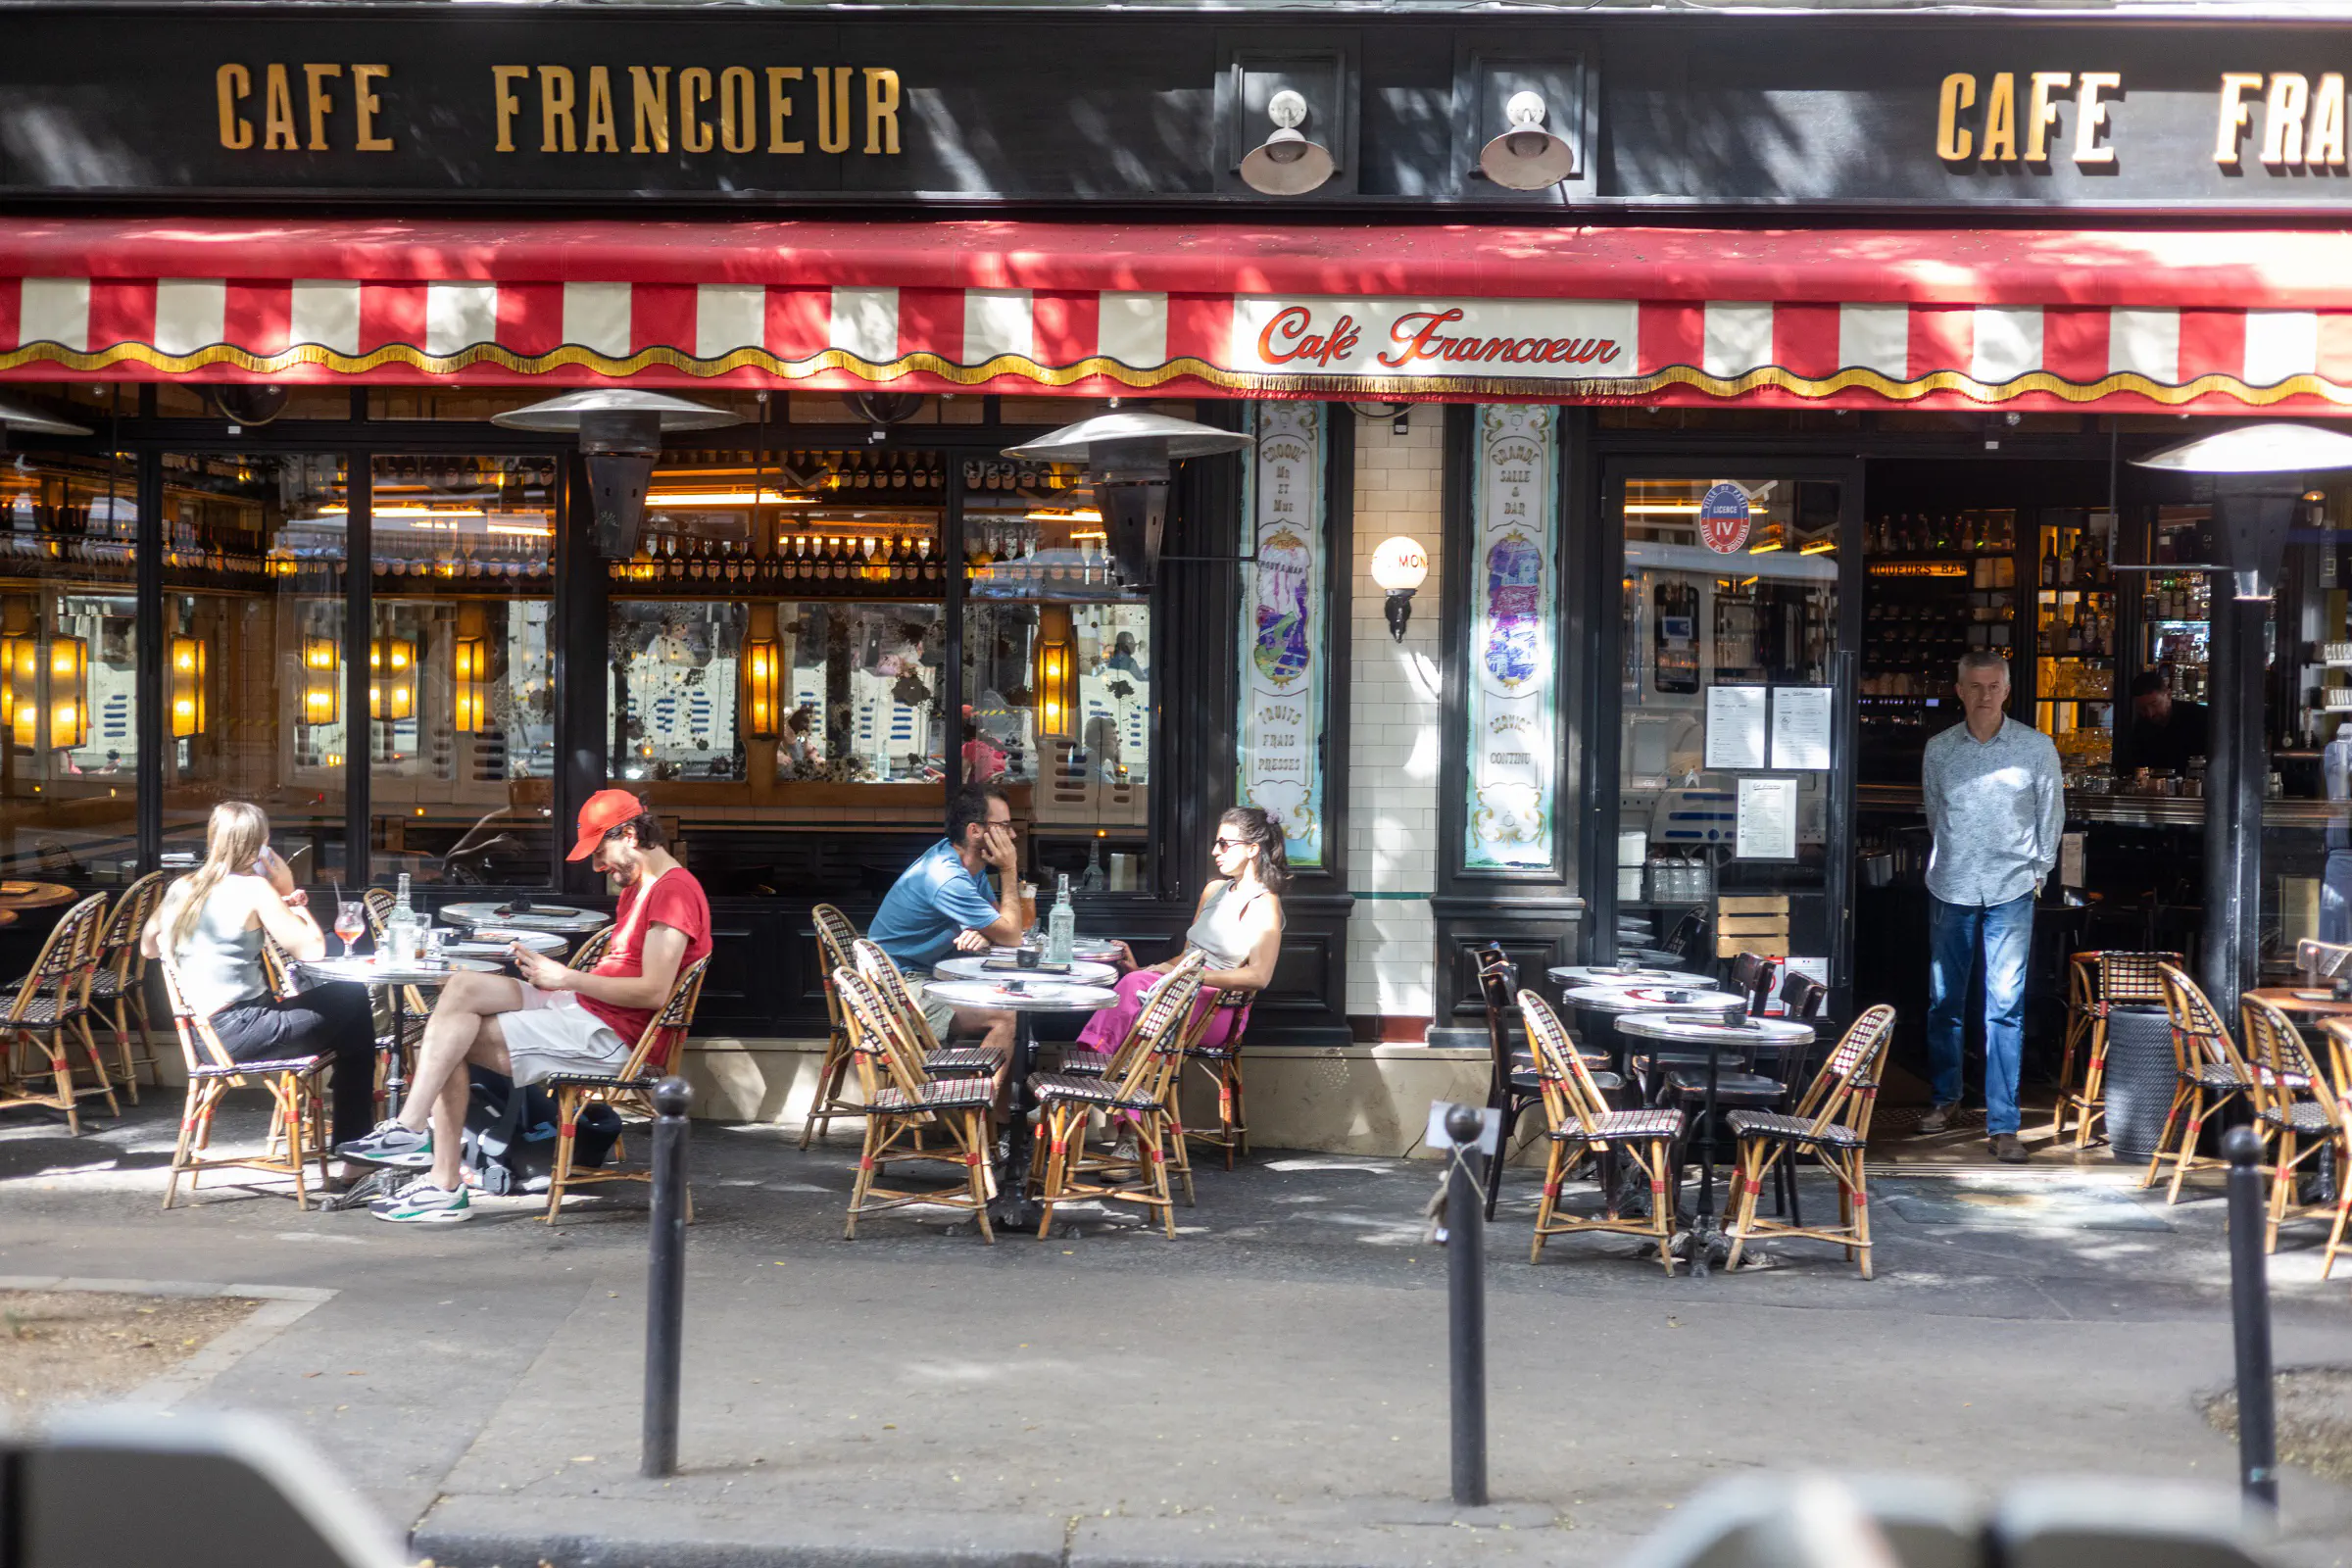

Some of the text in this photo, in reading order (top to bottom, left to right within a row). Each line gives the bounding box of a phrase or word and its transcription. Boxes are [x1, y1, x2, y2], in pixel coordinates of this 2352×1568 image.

[217, 64, 902, 154] CAFE FRANCOEUR
[1936, 73, 2346, 163] CAFE FRA
[1257, 306, 1361, 367] Café
[1262, 443, 1307, 464] CROQUE
[1492, 445, 1541, 466] GRANDE
[1500, 470, 1531, 482] SALLE
[1278, 483, 1290, 494] ET
[1504, 502, 1525, 517] BAR
[1716, 521, 1734, 536] IV
[1258, 706, 1301, 725] FRUITS
[1490, 714, 1532, 734] SERVICE
[1262, 734, 1295, 749] FRAIS
[1258, 758, 1300, 772] PRESSES
[1490, 752, 1531, 764] CONTINU
